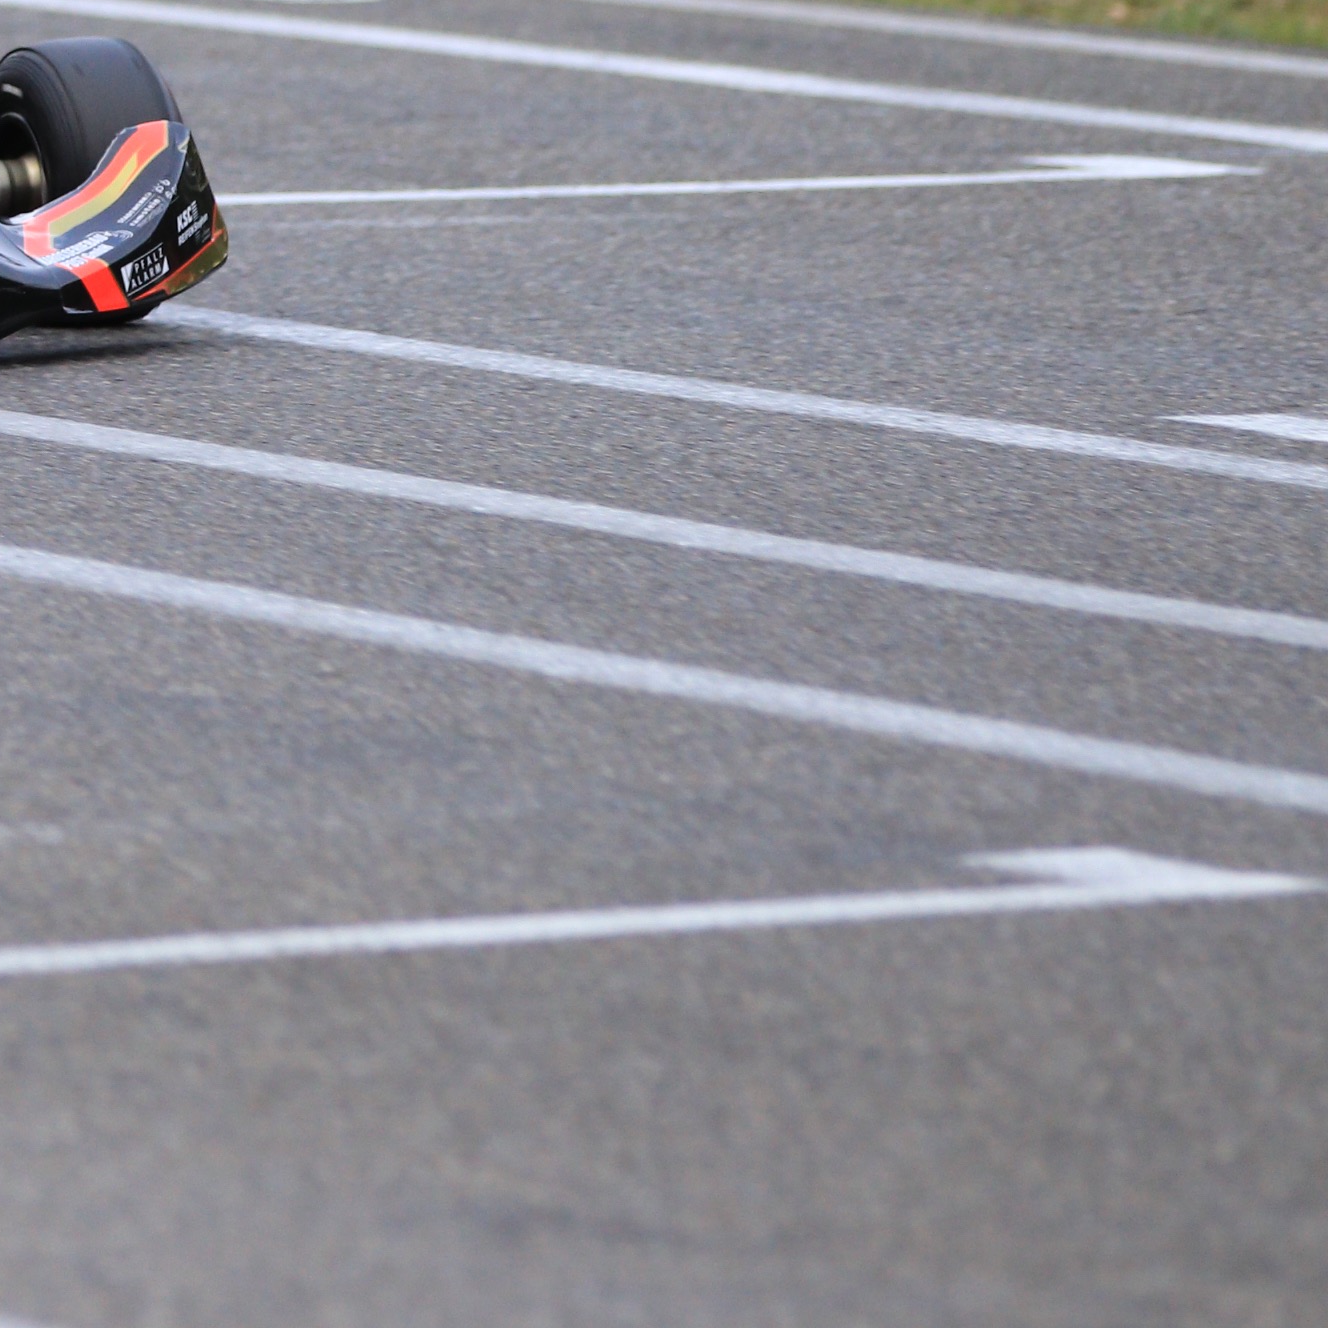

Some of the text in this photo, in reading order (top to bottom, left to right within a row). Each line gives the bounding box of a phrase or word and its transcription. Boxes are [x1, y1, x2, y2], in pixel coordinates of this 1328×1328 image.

[176, 205, 194, 233] KSC
[133, 247, 164, 272] PFALZ
[131, 264, 162, 290] ALARM
